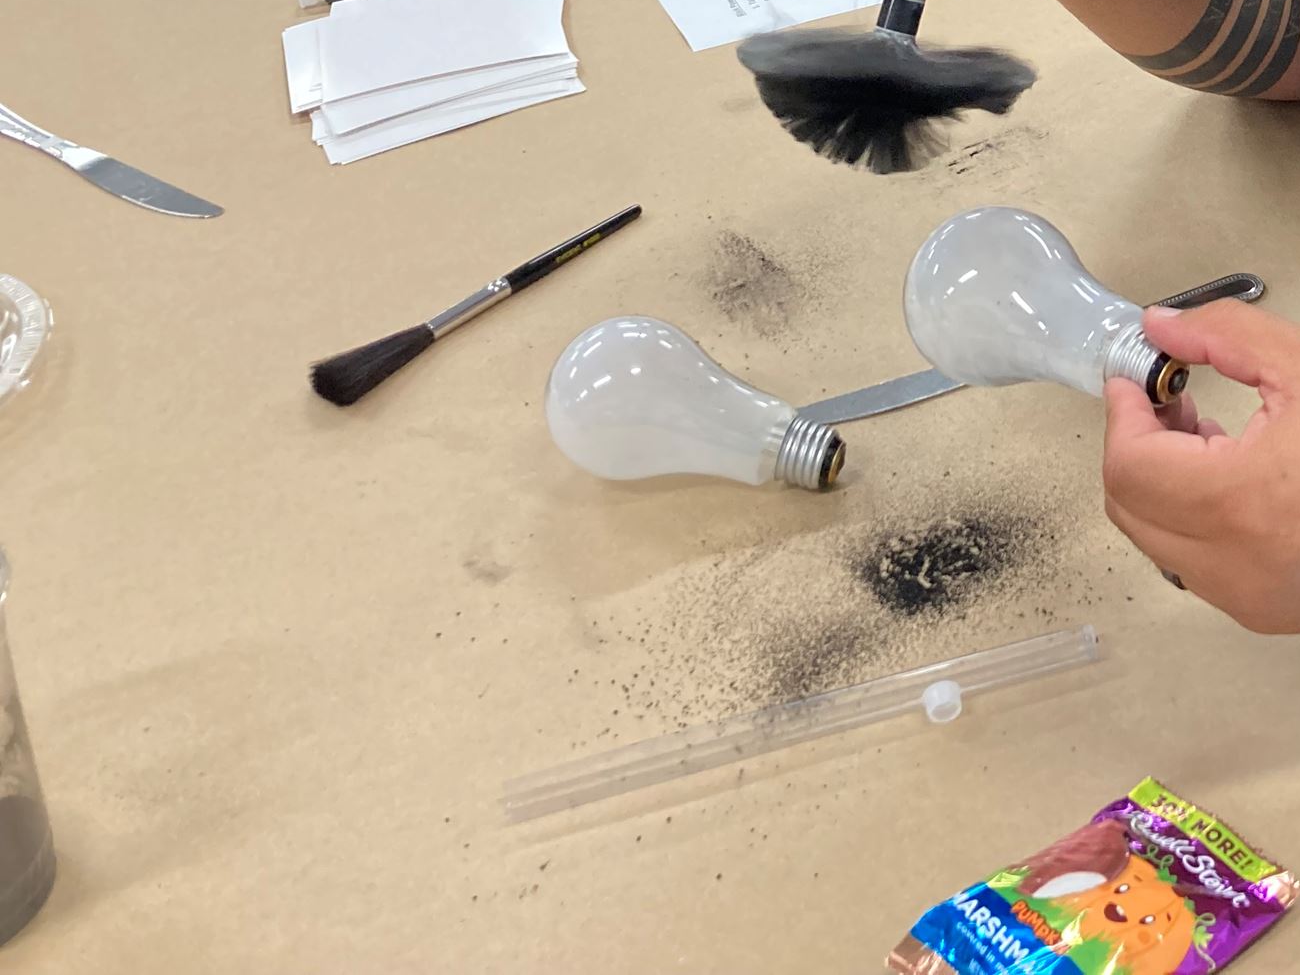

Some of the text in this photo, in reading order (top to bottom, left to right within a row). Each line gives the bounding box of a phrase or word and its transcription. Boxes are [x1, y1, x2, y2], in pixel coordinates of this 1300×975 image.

[1191, 820, 1254, 871] MORE!
[1181, 854, 1251, 909] Stover
[956, 921, 988, 955] covered
[1010, 899, 1073, 956] PUMPKN
